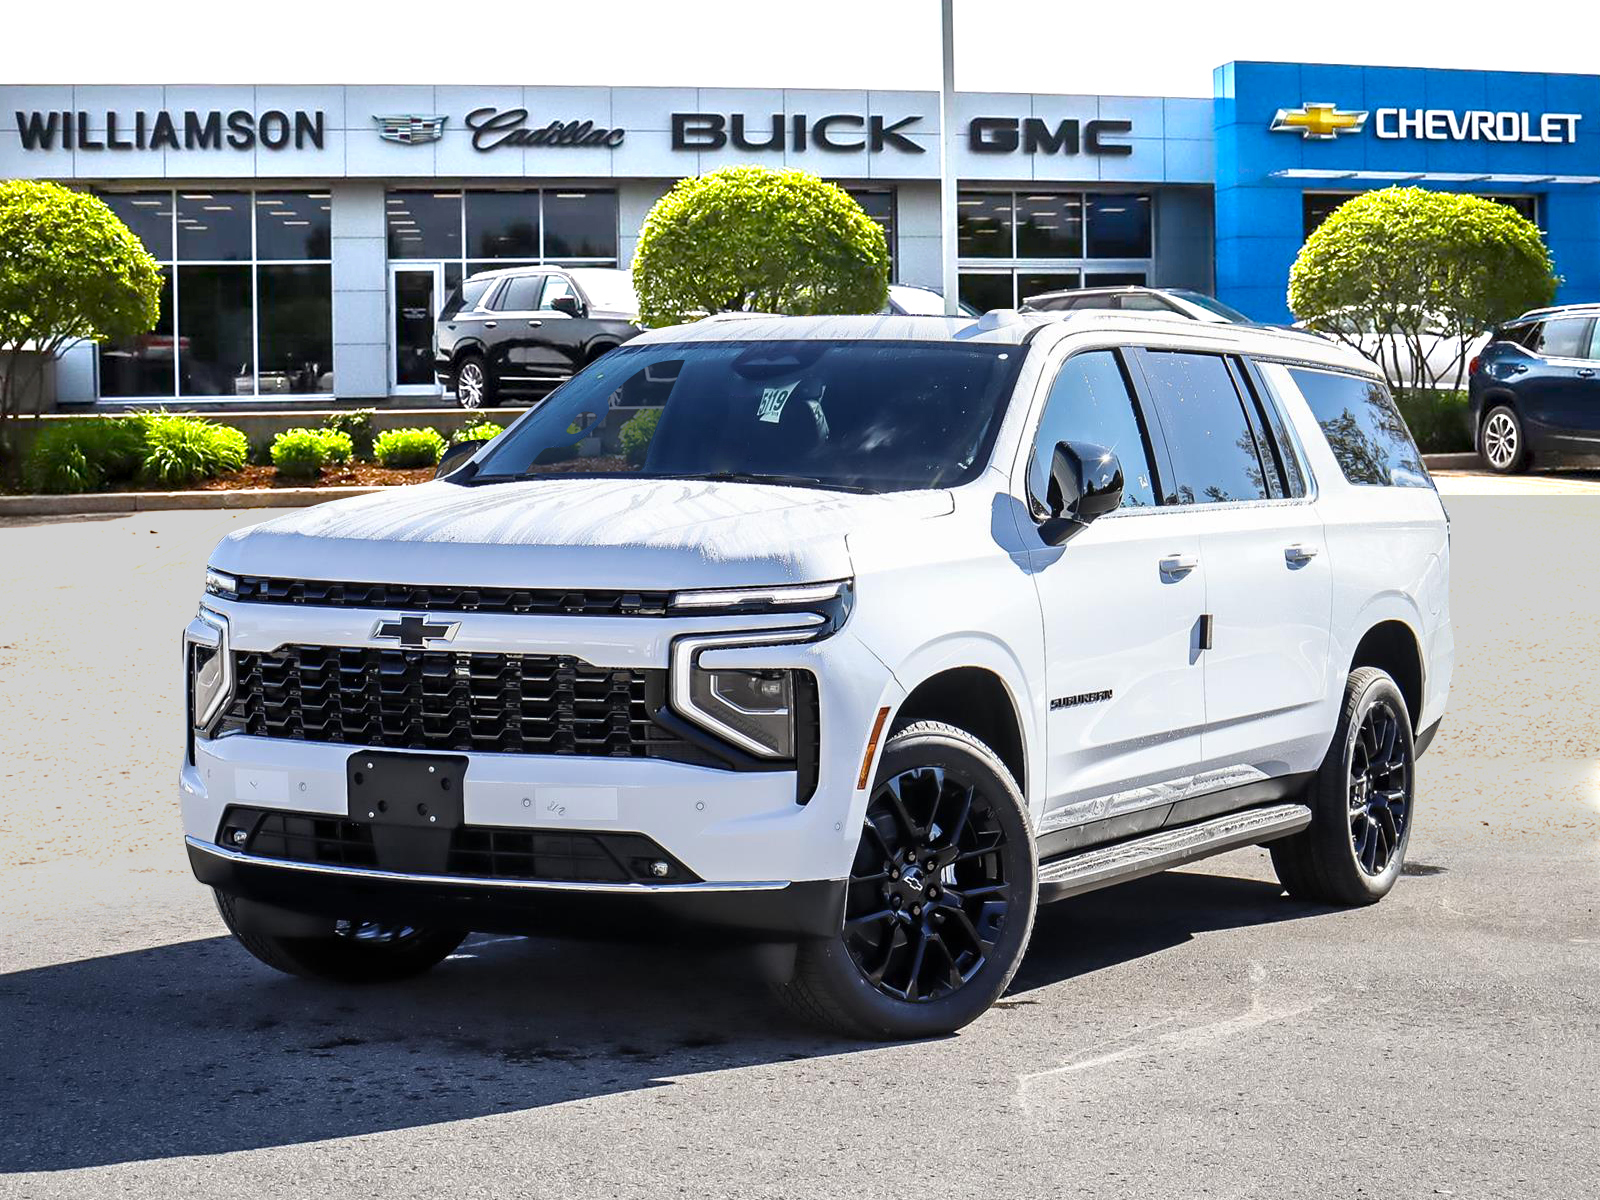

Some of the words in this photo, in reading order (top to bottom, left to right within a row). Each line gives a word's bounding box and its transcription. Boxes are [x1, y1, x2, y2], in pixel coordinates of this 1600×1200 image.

[16, 111, 324, 150] WILLIAMSON
[465, 107, 625, 152] Cadillac
[671, 113, 926, 153] BUICK
[970, 117, 1133, 155] GMC
[1376, 108, 1582, 143] CHEVROLET
[1050, 689, 1113, 711] SUBURBAN
